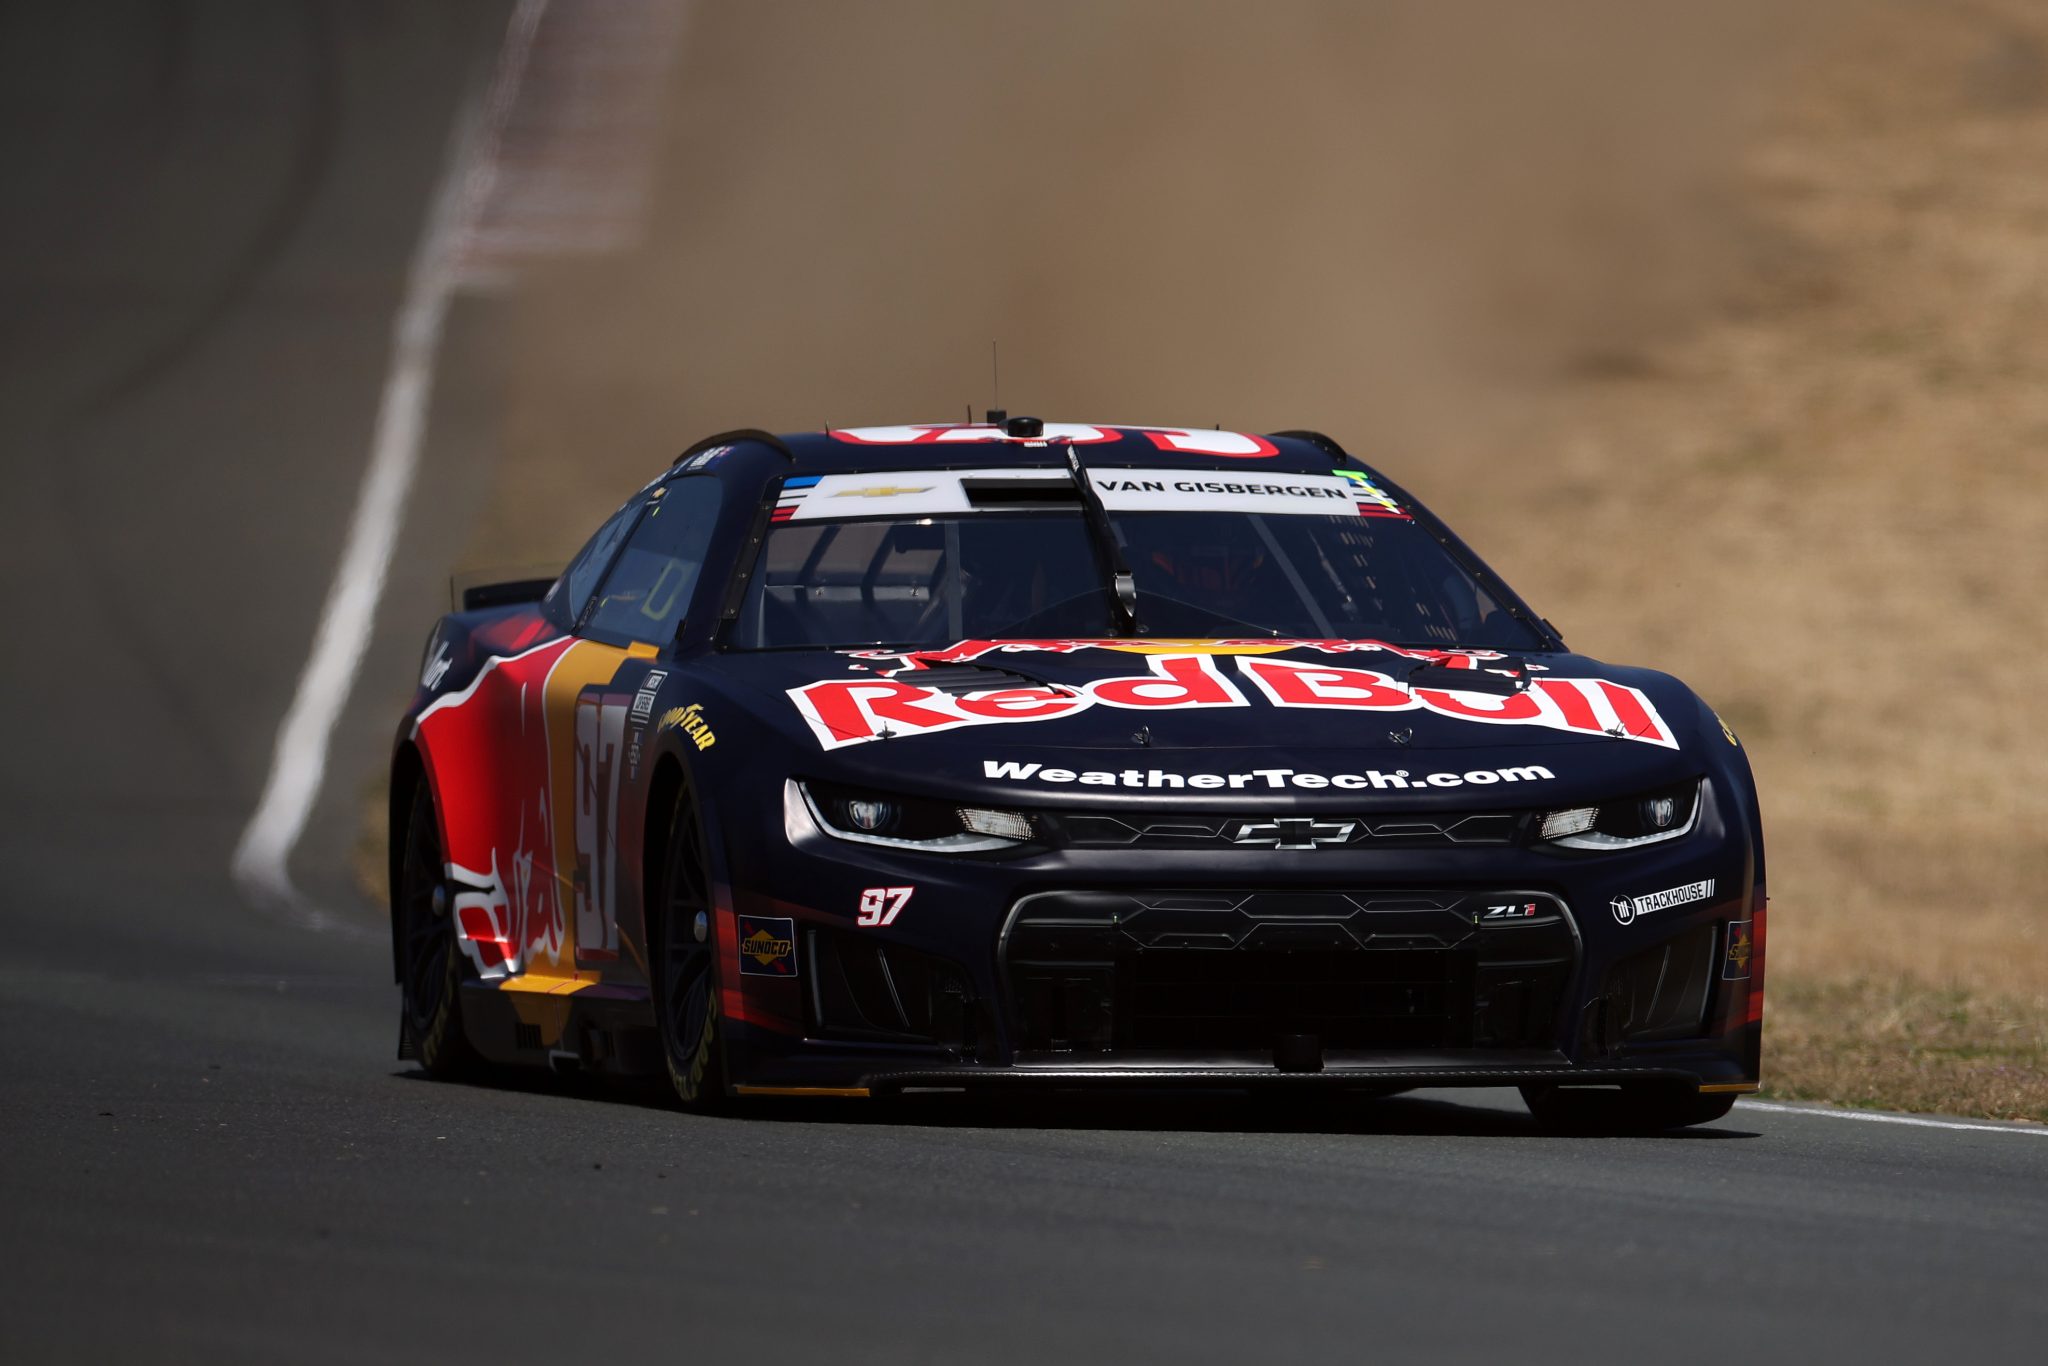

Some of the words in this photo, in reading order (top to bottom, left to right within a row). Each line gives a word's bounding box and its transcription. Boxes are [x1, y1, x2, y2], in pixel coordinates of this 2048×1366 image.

[1096, 480, 1165, 493] VAN
[1173, 482, 1347, 500] GISBERGEN
[790, 653, 1242, 749] Red
[575, 696, 631, 955] 97
[857, 886, 915, 927] 97
[1483, 903, 1536, 919] ZL1
[1637, 883, 1705, 913] TRACKHOUSE
[742, 939, 789, 956] SUNOCO
